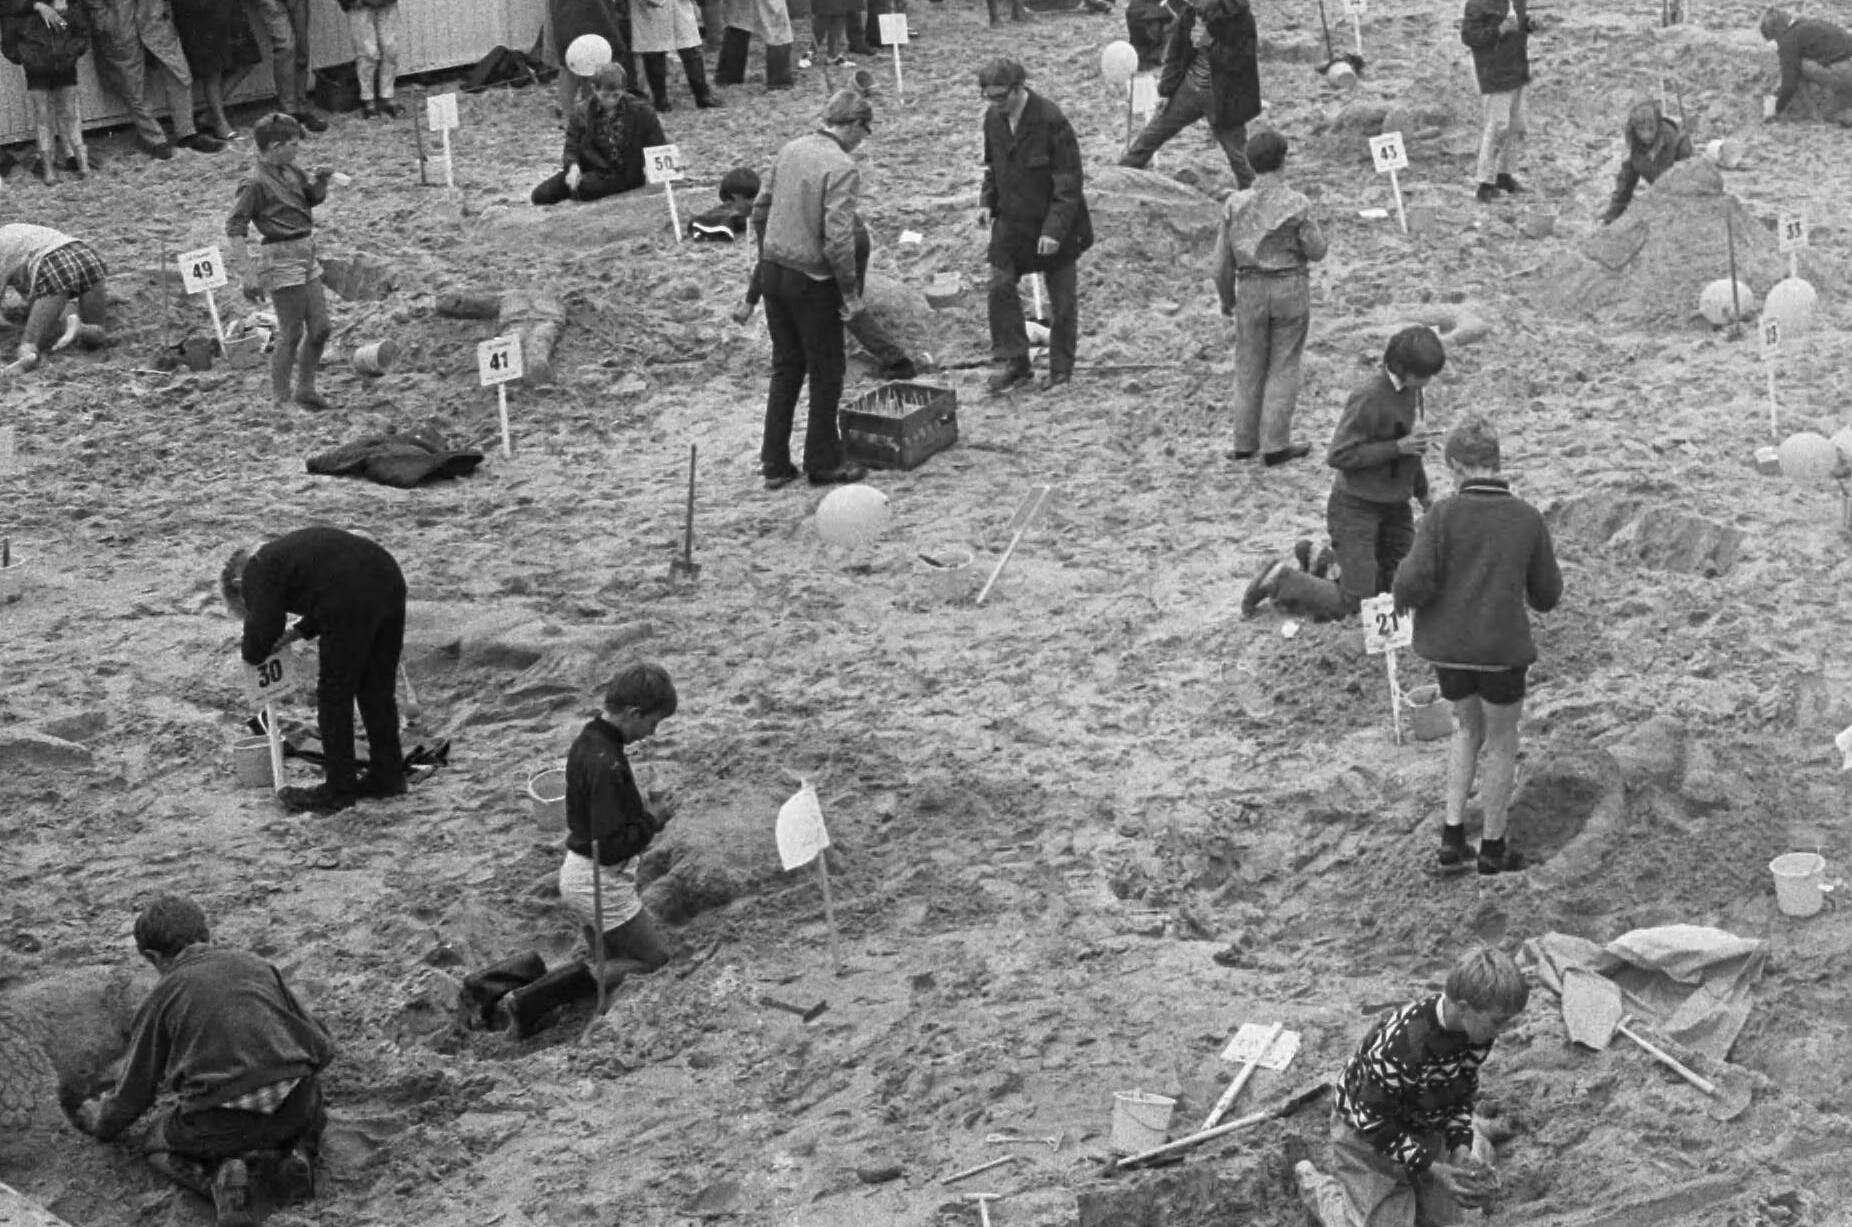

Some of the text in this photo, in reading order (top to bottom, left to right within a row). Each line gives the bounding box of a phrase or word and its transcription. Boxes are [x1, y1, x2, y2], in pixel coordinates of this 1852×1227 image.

[1380, 144, 1398, 161] 43
[654, 155, 673, 172] 50
[192, 260, 214, 279] 49
[489, 351, 509, 371] 41
[1375, 611, 1400, 637] 21
[256, 658, 282, 688] 30
